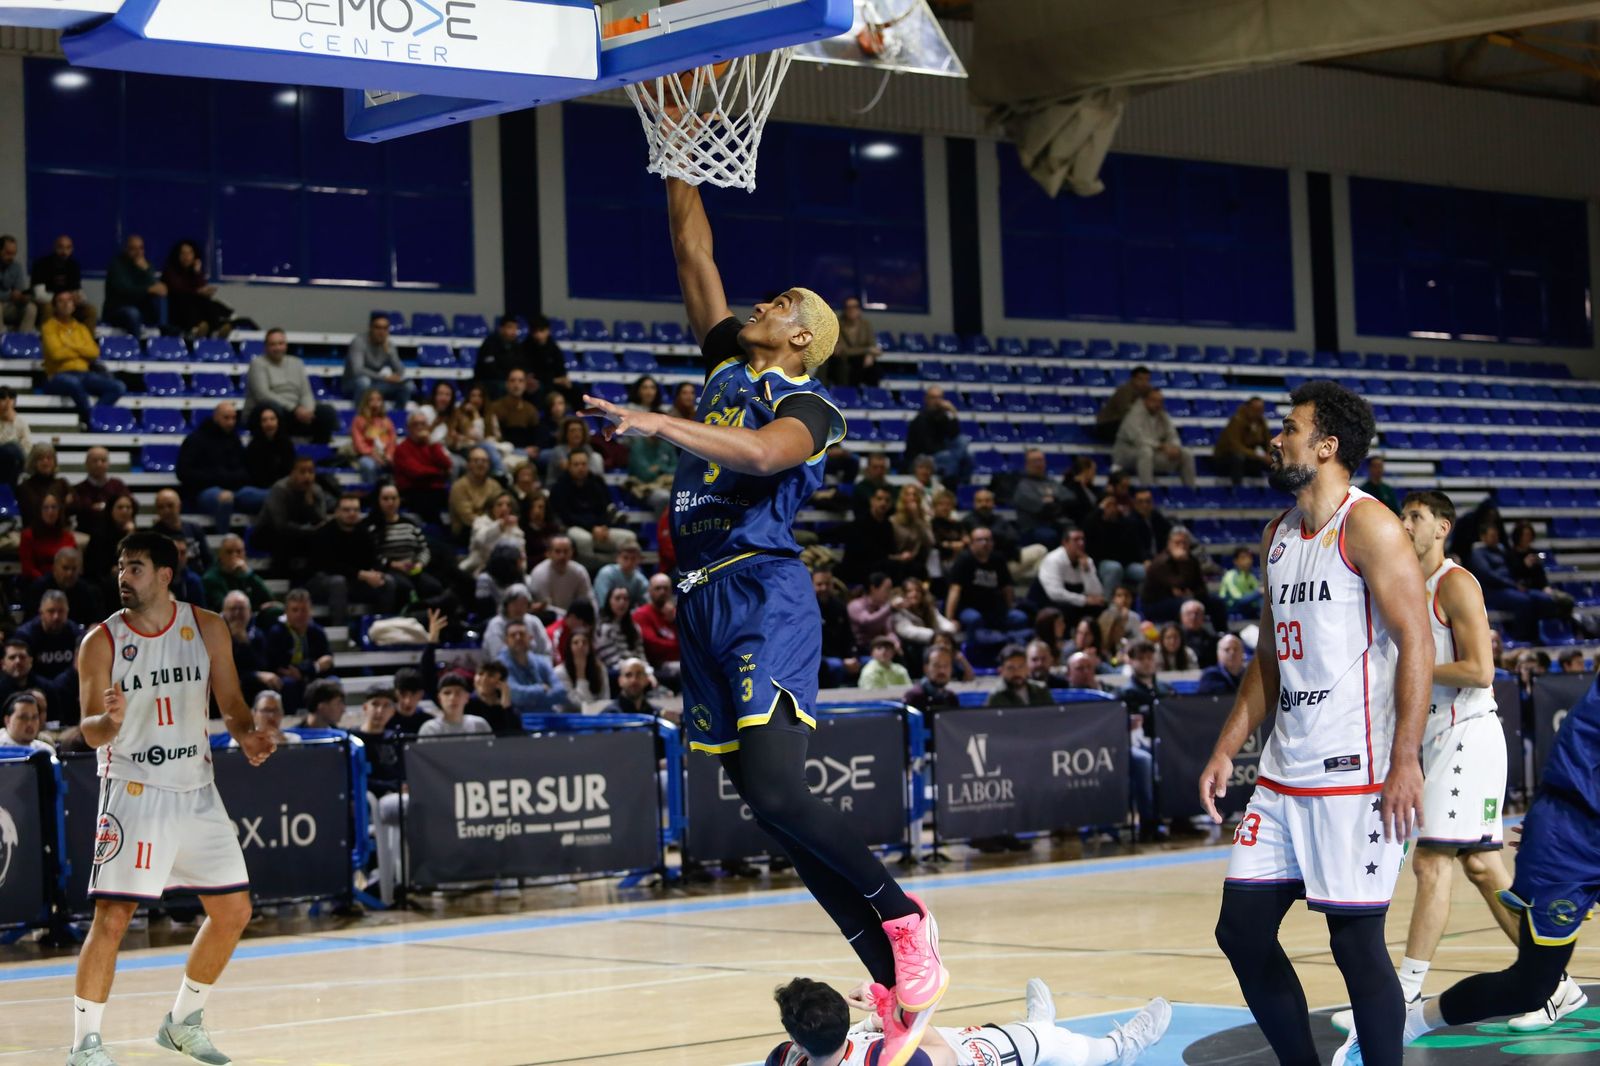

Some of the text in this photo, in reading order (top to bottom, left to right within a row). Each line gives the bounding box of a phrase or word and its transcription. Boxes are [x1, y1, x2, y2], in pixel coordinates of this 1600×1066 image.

[299, 32, 448, 63] CENTER
[1279, 580, 1332, 605] ZUBIA
[1276, 620, 1304, 661] 33
[121, 665, 202, 692] LA ZUBIA
[741, 676, 754, 703] 3
[155, 696, 175, 726] 11
[1052, 747, 1114, 777] ROA
[454, 773, 610, 819] IBERSUR
[948, 778, 1014, 804] LABOR
[457, 818, 522, 841] Energía
[134, 841, 152, 869] 11
